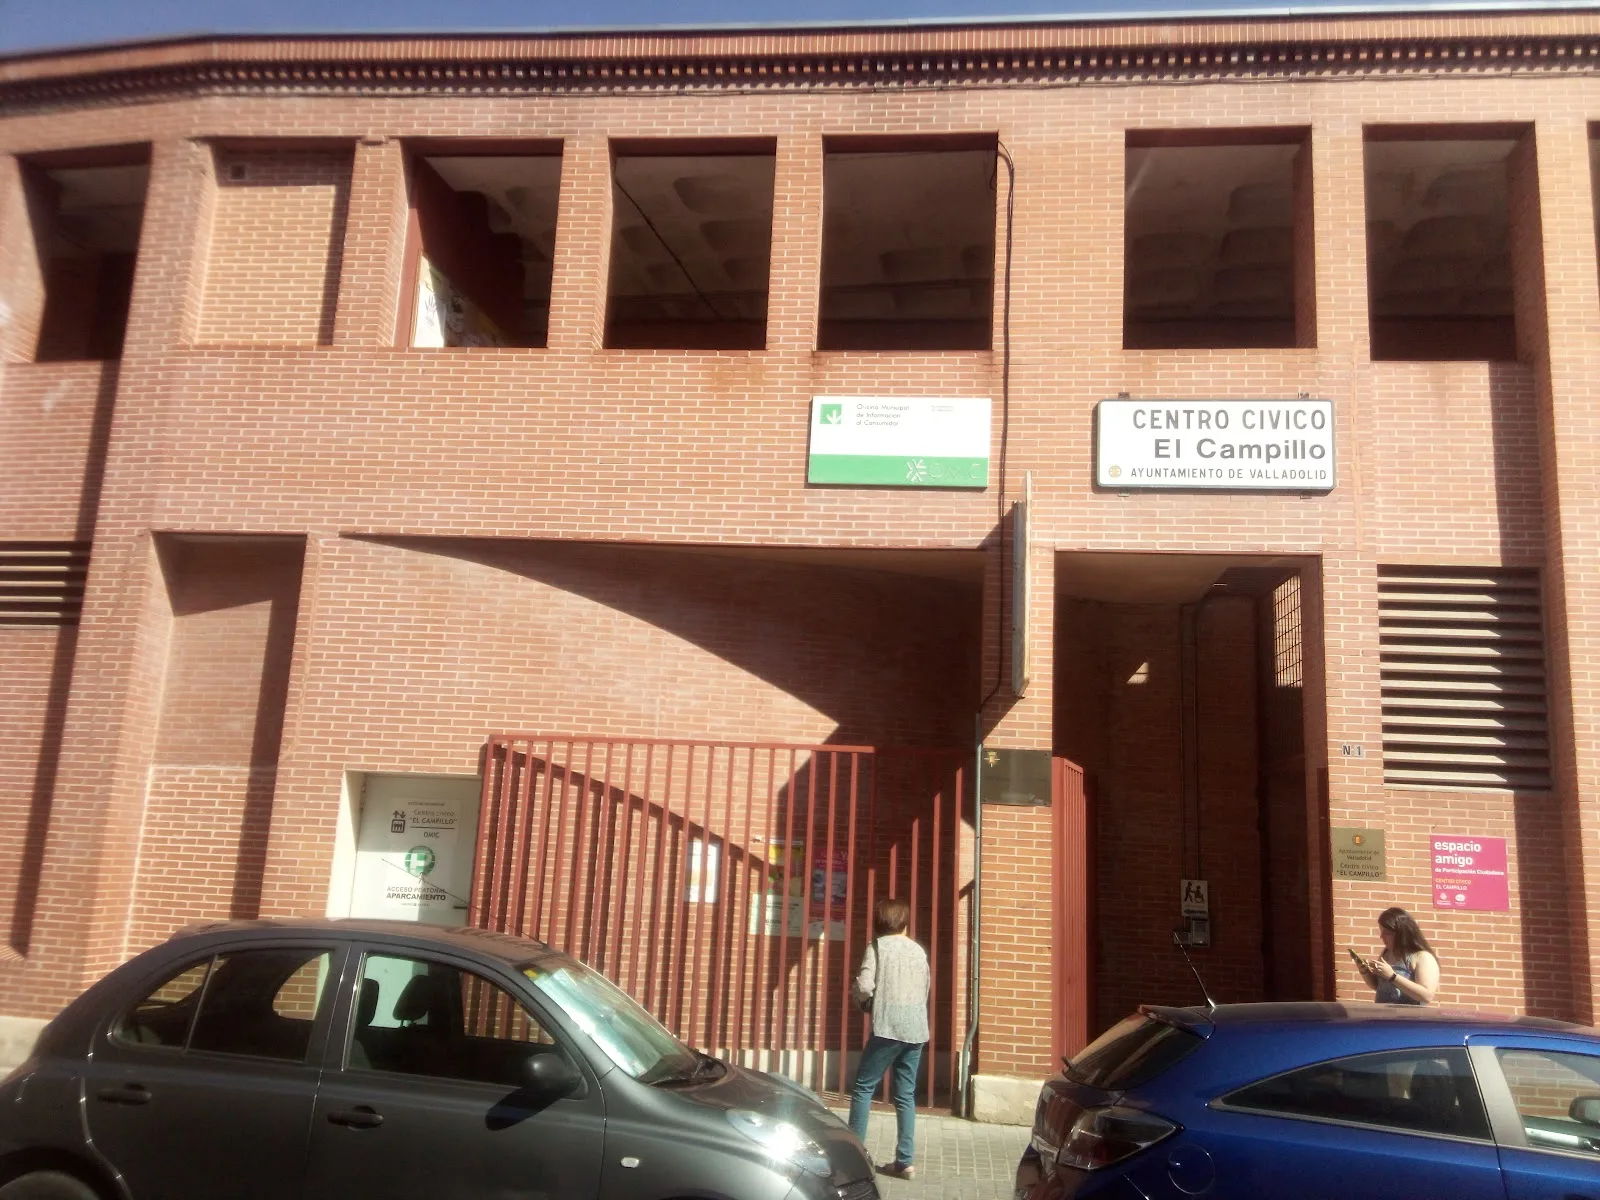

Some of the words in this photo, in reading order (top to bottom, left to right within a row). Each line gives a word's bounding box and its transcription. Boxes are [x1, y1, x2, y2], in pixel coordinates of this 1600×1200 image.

[1132, 409, 1230, 430] CENTRO
[1241, 409, 1326, 430] CIVICO
[1153, 438, 1181, 459] El
[1196, 438, 1326, 464] Campillo
[1130, 467, 1223, 479] AYUNTAMIENTO
[1228, 468, 1243, 479] DE
[1249, 468, 1327, 480] VALLADOLID
[1342, 745, 1351, 756] N
[1356, 745, 1362, 756] 1
[423, 831, 440, 839] OMIC
[1434, 840, 1482, 853] espacio
[1434, 853, 1474, 868] amigo
[386, 892, 446, 901] APARCAMIENTO
